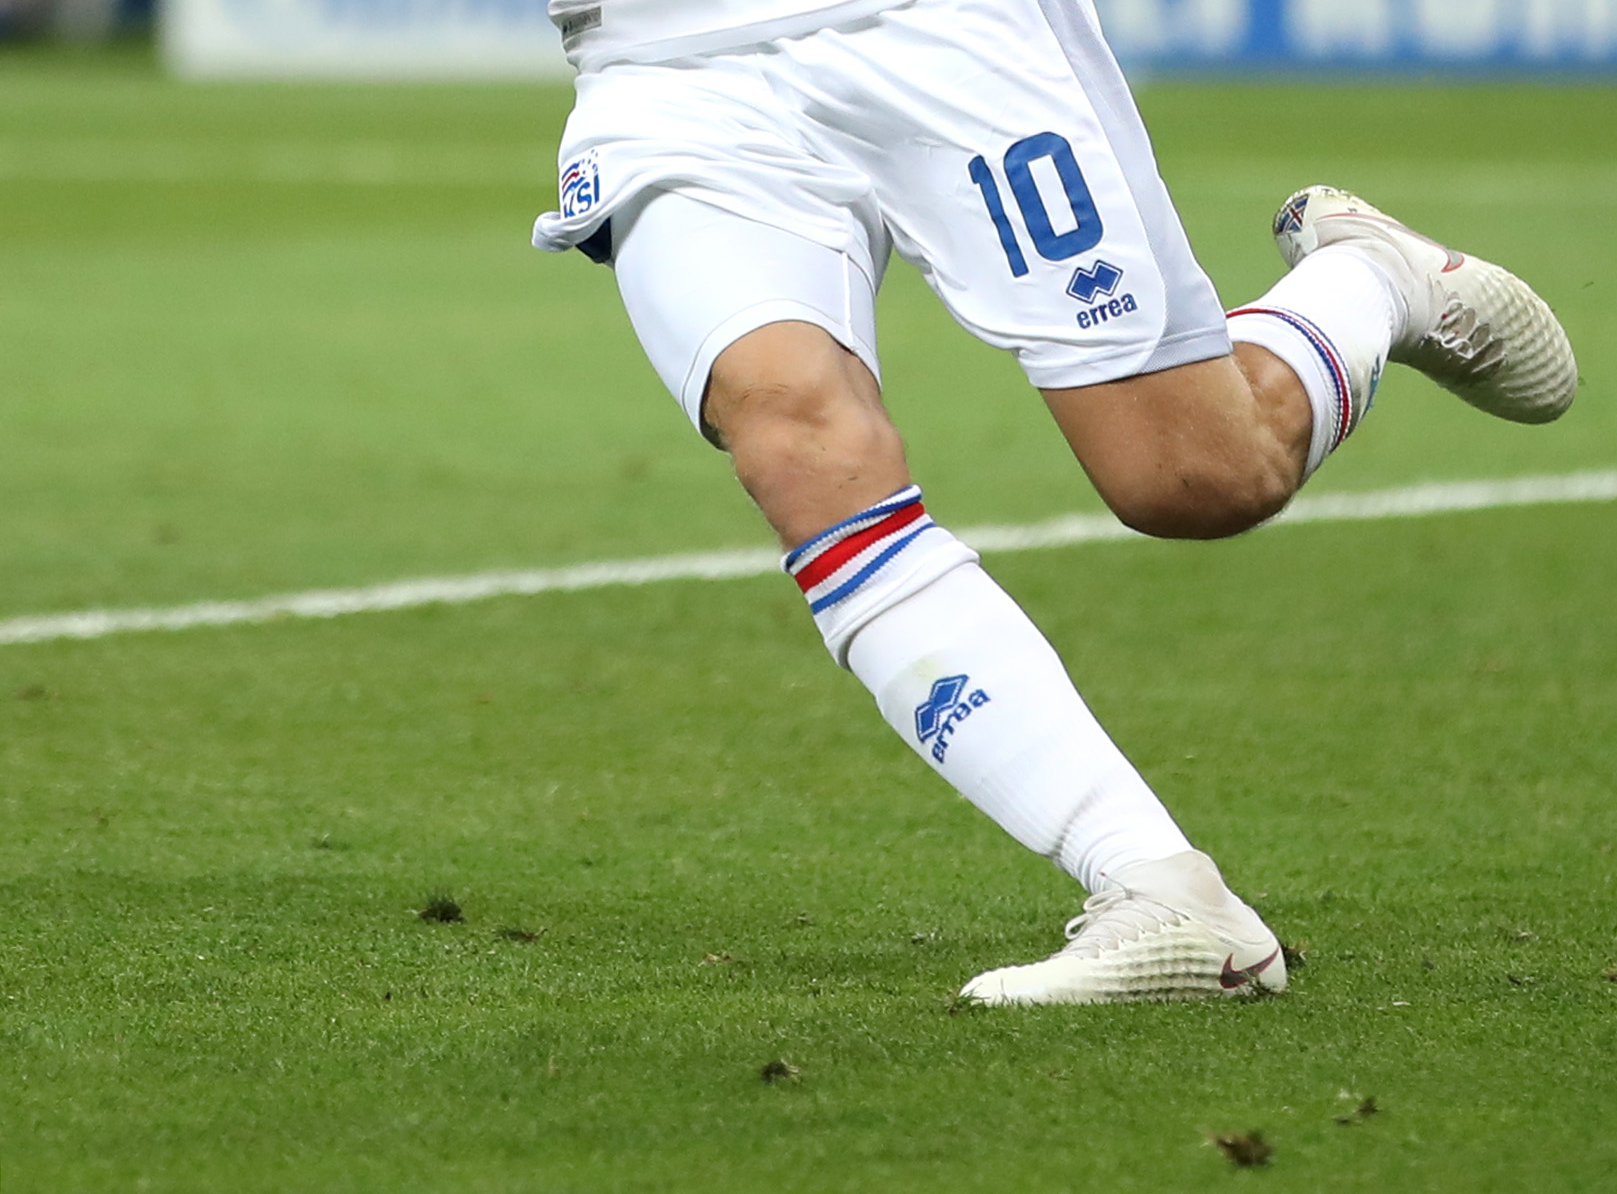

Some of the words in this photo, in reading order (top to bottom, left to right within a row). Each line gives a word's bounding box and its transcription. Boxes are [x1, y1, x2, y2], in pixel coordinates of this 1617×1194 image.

[968, 131, 1104, 278] 10
[1076, 293, 1138, 330] errea
[931, 689, 991, 764] errea
